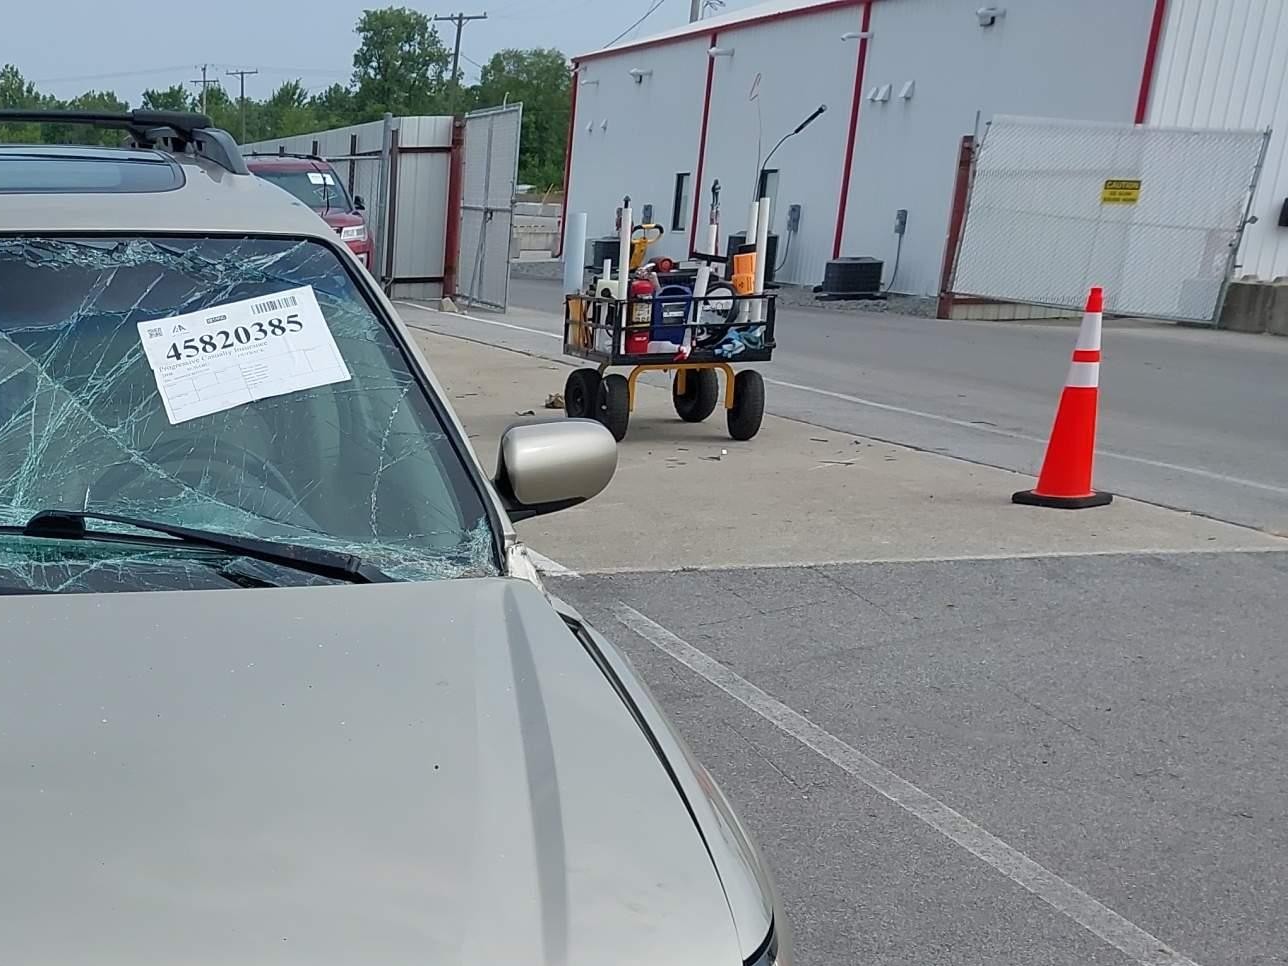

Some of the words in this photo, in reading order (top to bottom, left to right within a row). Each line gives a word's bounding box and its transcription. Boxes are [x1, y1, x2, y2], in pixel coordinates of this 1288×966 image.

[158, 358, 200, 373] Progressive
[201, 349, 232, 362] Casualty
[233, 341, 268, 353] Insurance
[166, 313, 303, 361] 45820385
